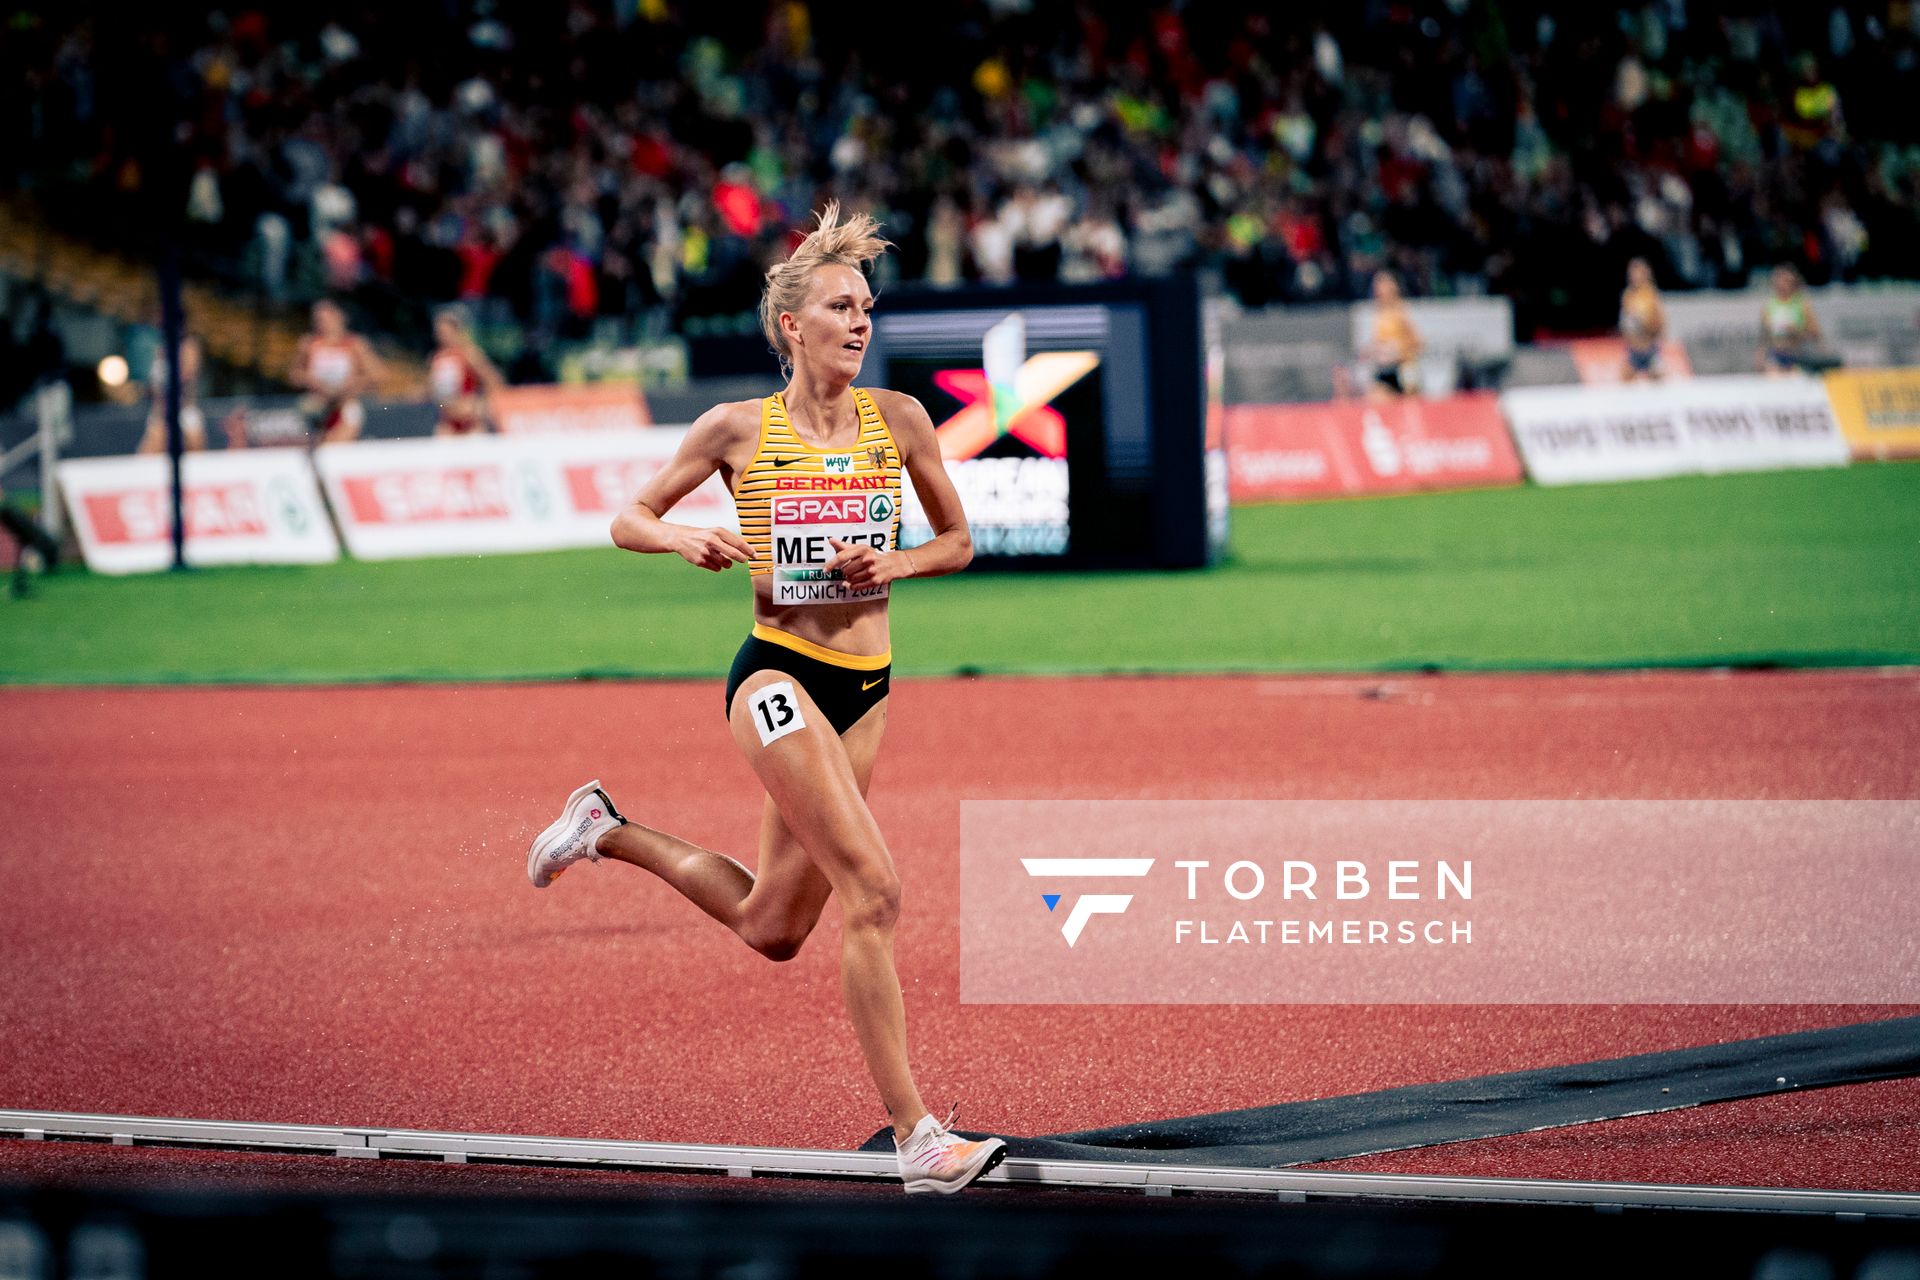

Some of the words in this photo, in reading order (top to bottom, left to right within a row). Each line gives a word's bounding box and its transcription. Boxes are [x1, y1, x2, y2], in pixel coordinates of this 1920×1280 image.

[775, 475, 888, 491] GERMANY
[777, 499, 865, 521] SPAR
[776, 533, 886, 564] MER
[802, 570, 806, 580] I
[808, 570, 832, 580] RUN
[781, 584, 847, 600] MUNICH
[757, 693, 794, 733] 13
